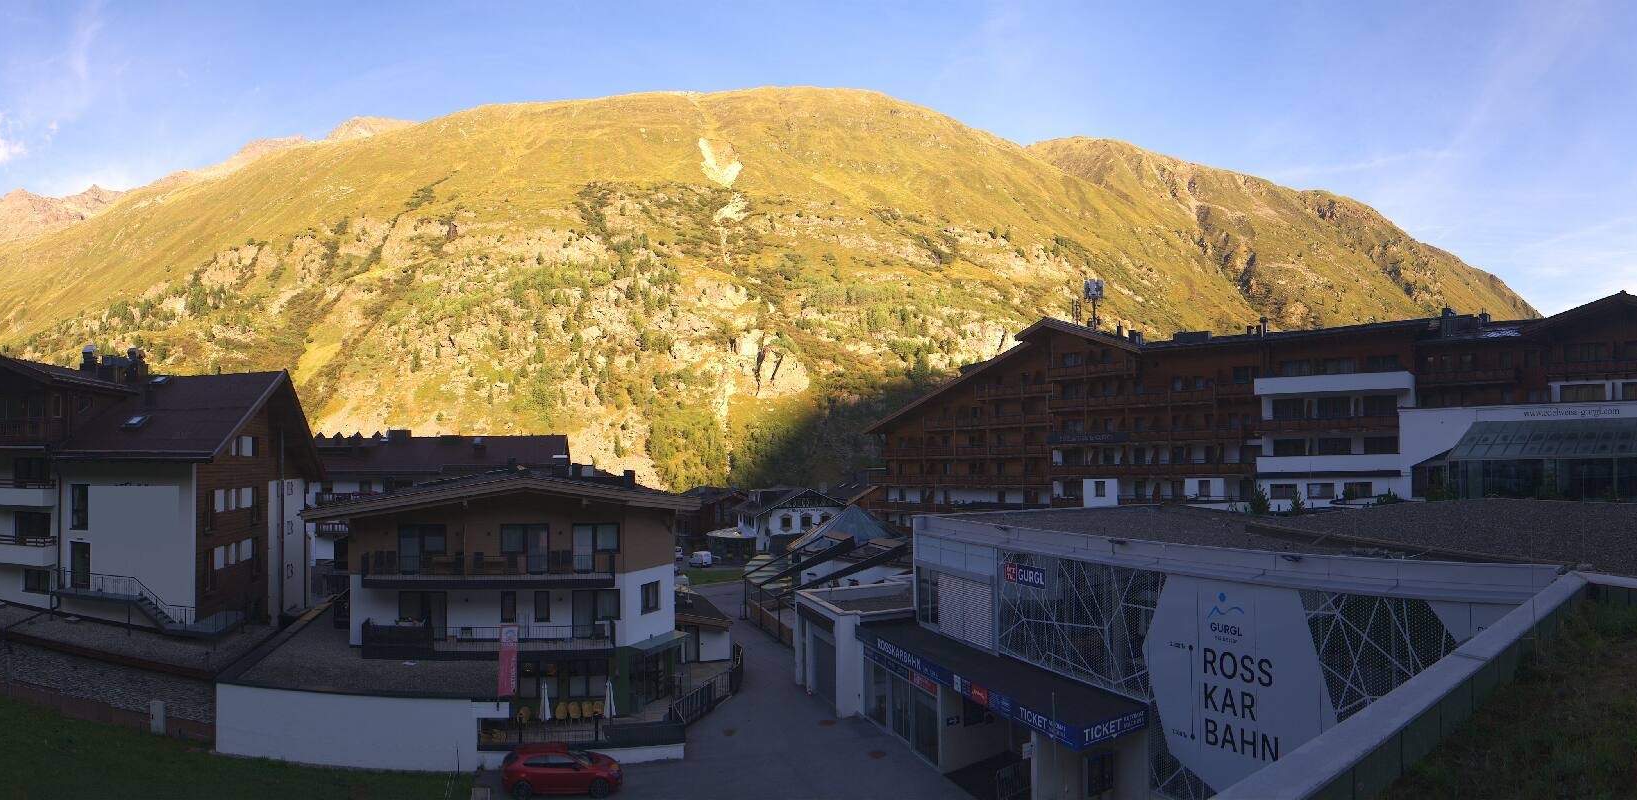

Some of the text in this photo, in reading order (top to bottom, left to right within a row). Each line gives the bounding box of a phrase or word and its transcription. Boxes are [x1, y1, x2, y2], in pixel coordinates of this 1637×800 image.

[1018, 568, 1045, 585] GURGL
[1210, 622, 1243, 637] GURGL
[876, 638, 921, 669] ROSSKARBAHN
[1203, 647, 1273, 687] ROSS
[1204, 682, 1257, 721] KAR
[1019, 707, 1047, 730] TICKET
[1083, 718, 1123, 742] TICKET
[1205, 718, 1279, 762] BAHN
